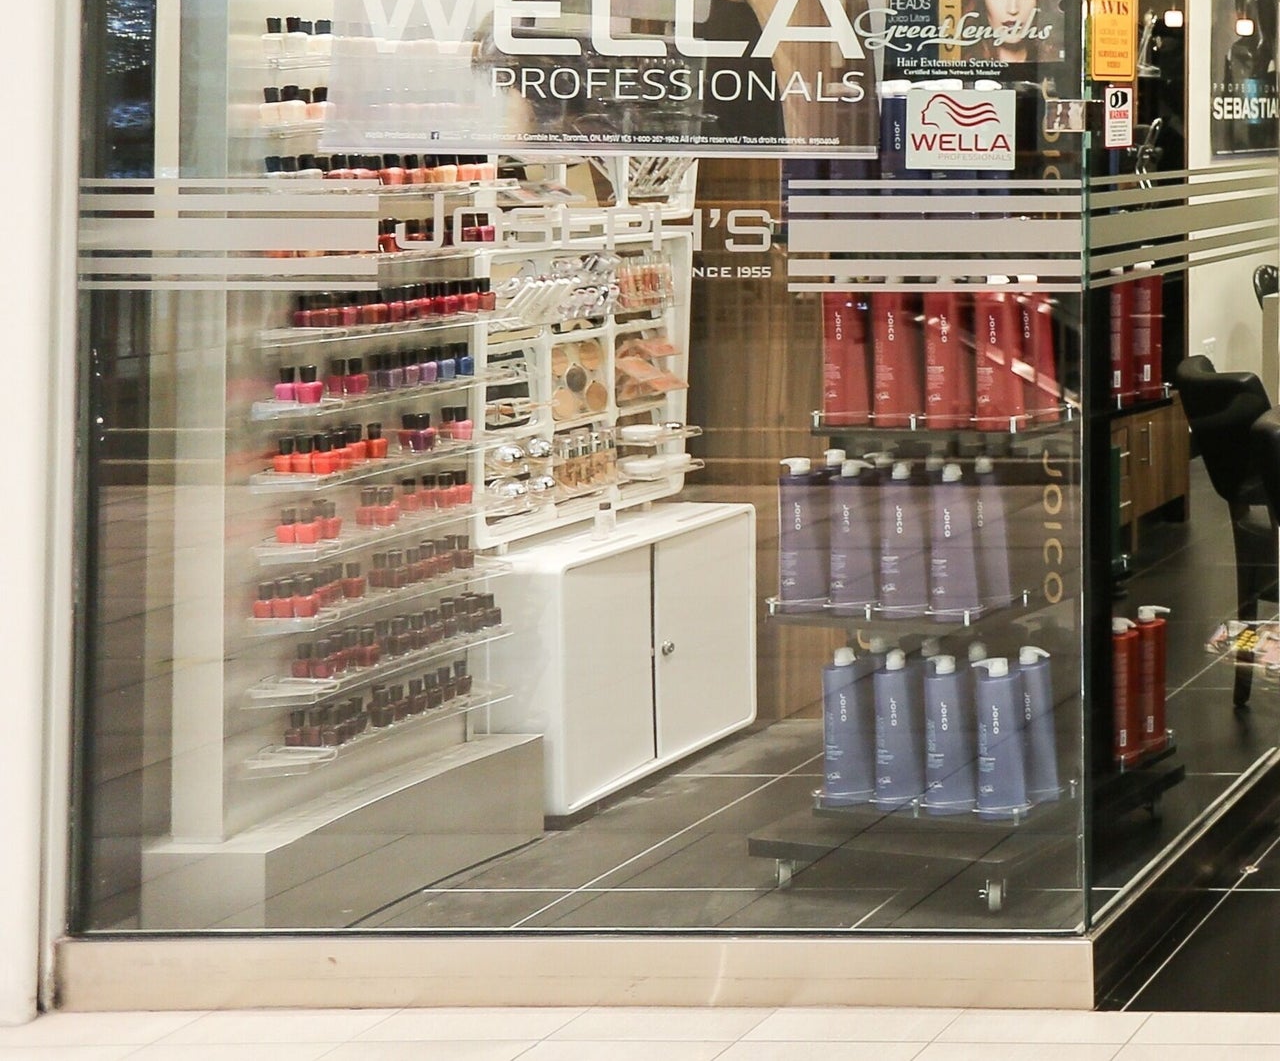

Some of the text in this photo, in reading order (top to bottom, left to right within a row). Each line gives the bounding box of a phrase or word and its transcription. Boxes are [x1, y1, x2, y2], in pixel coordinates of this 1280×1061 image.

[853, 7, 949, 52] Great
[896, 57, 1009, 68] Hair Extension Services
[903, 68, 931, 76] Certified
[490, 67, 866, 103] PROFESSIONALS
[690, 134, 709, 145] rights
[910, 132, 1012, 152] WELLA
[938, 152, 1013, 162] PROFESSIONALS
[395, 192, 772, 253] JOSEPH'S
[737, 266, 771, 278] 1955
[834, 312, 842, 340] JOICO
[887, 311, 895, 341] JOICO
[988, 314, 997, 344] JOICO
[895, 505, 903, 534] JOICO
[943, 508, 951, 538] JOICO
[1042, 449, 1063, 604] JOICO
[839, 693, 847, 722] JOICO
[889, 697, 898, 726] JOICO
[940, 701, 948, 731] JOICO
[991, 705, 1000, 735] JOICO
